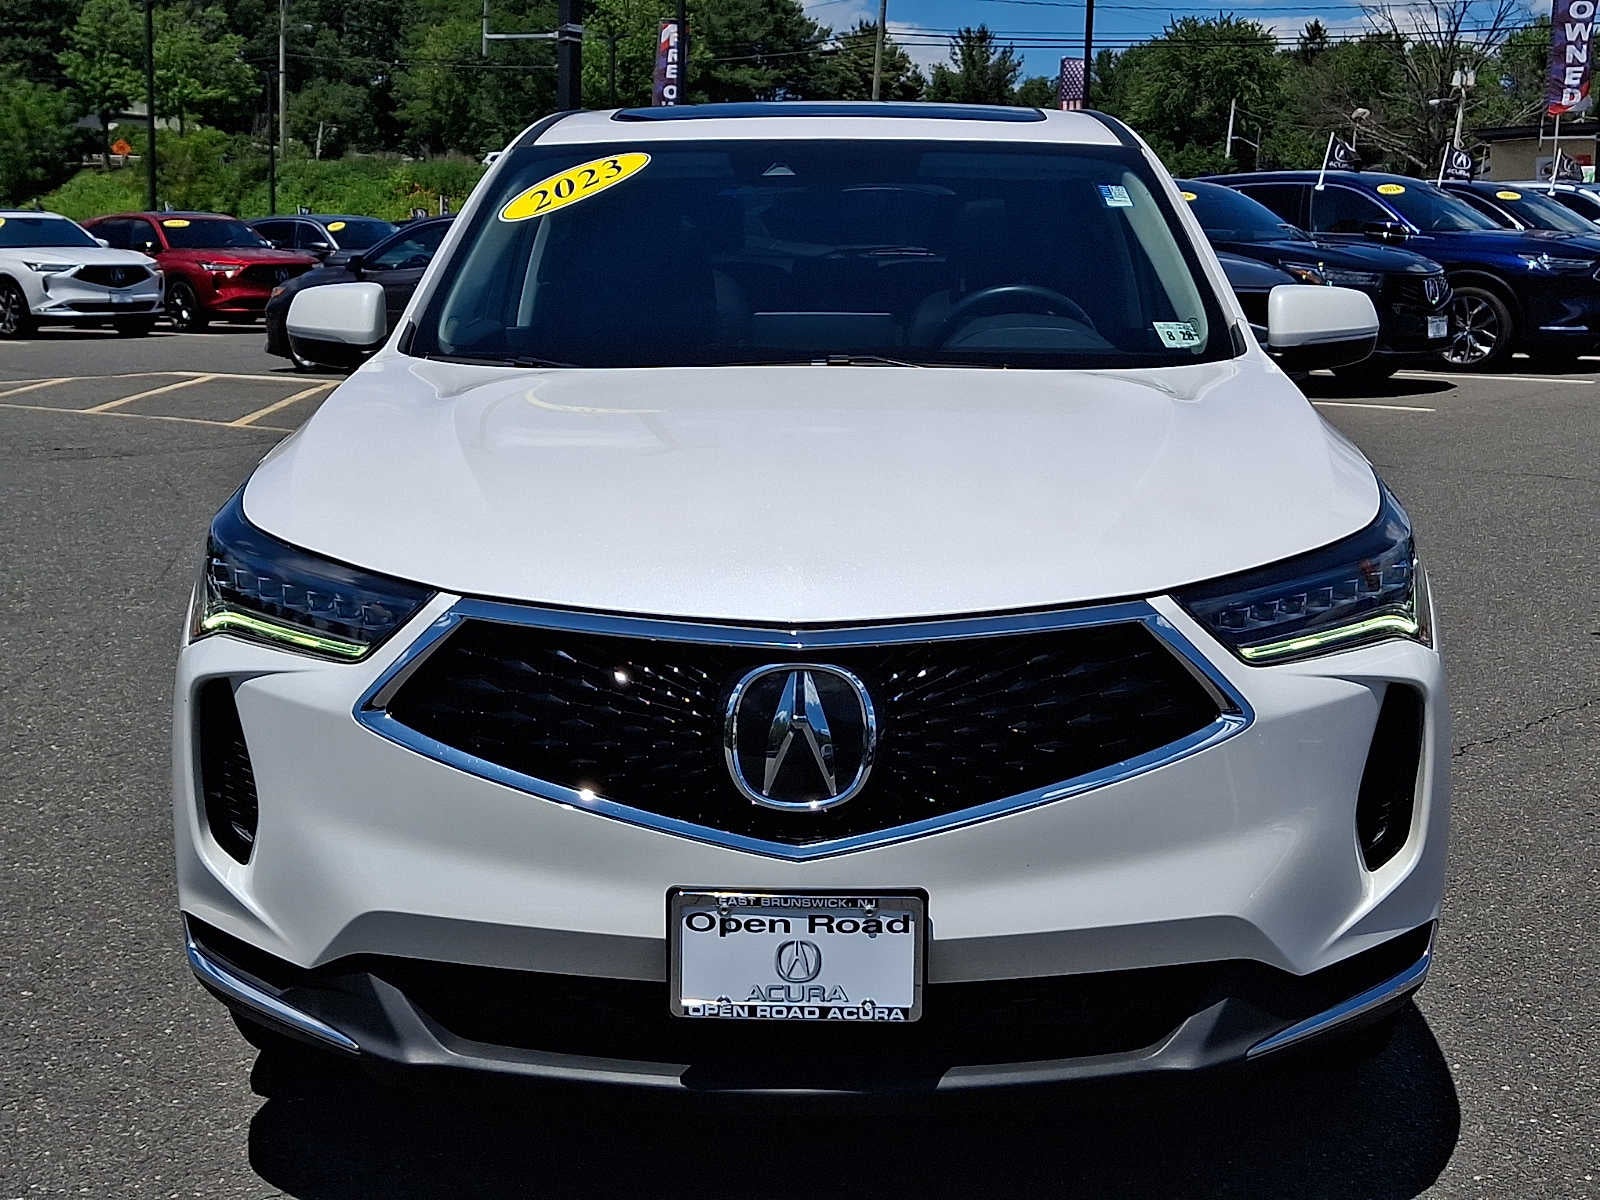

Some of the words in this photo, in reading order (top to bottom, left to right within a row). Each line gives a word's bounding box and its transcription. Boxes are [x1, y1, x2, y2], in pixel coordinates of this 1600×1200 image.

[1561, 1, 1594, 106] OWNED
[530, 159, 622, 212] 2023
[1166, 330, 1176, 341] 8
[1179, 330, 1195, 341] 28
[718, 896, 757, 907] EAST
[857, 898, 876, 908] NJ
[685, 911, 792, 938] Open
[807, 914, 911, 934] Road
[746, 984, 849, 1003] ACURA
[688, 1003, 749, 1018] OPEN
[756, 1005, 820, 1020] ROAD
[827, 1006, 905, 1021] ACURA
